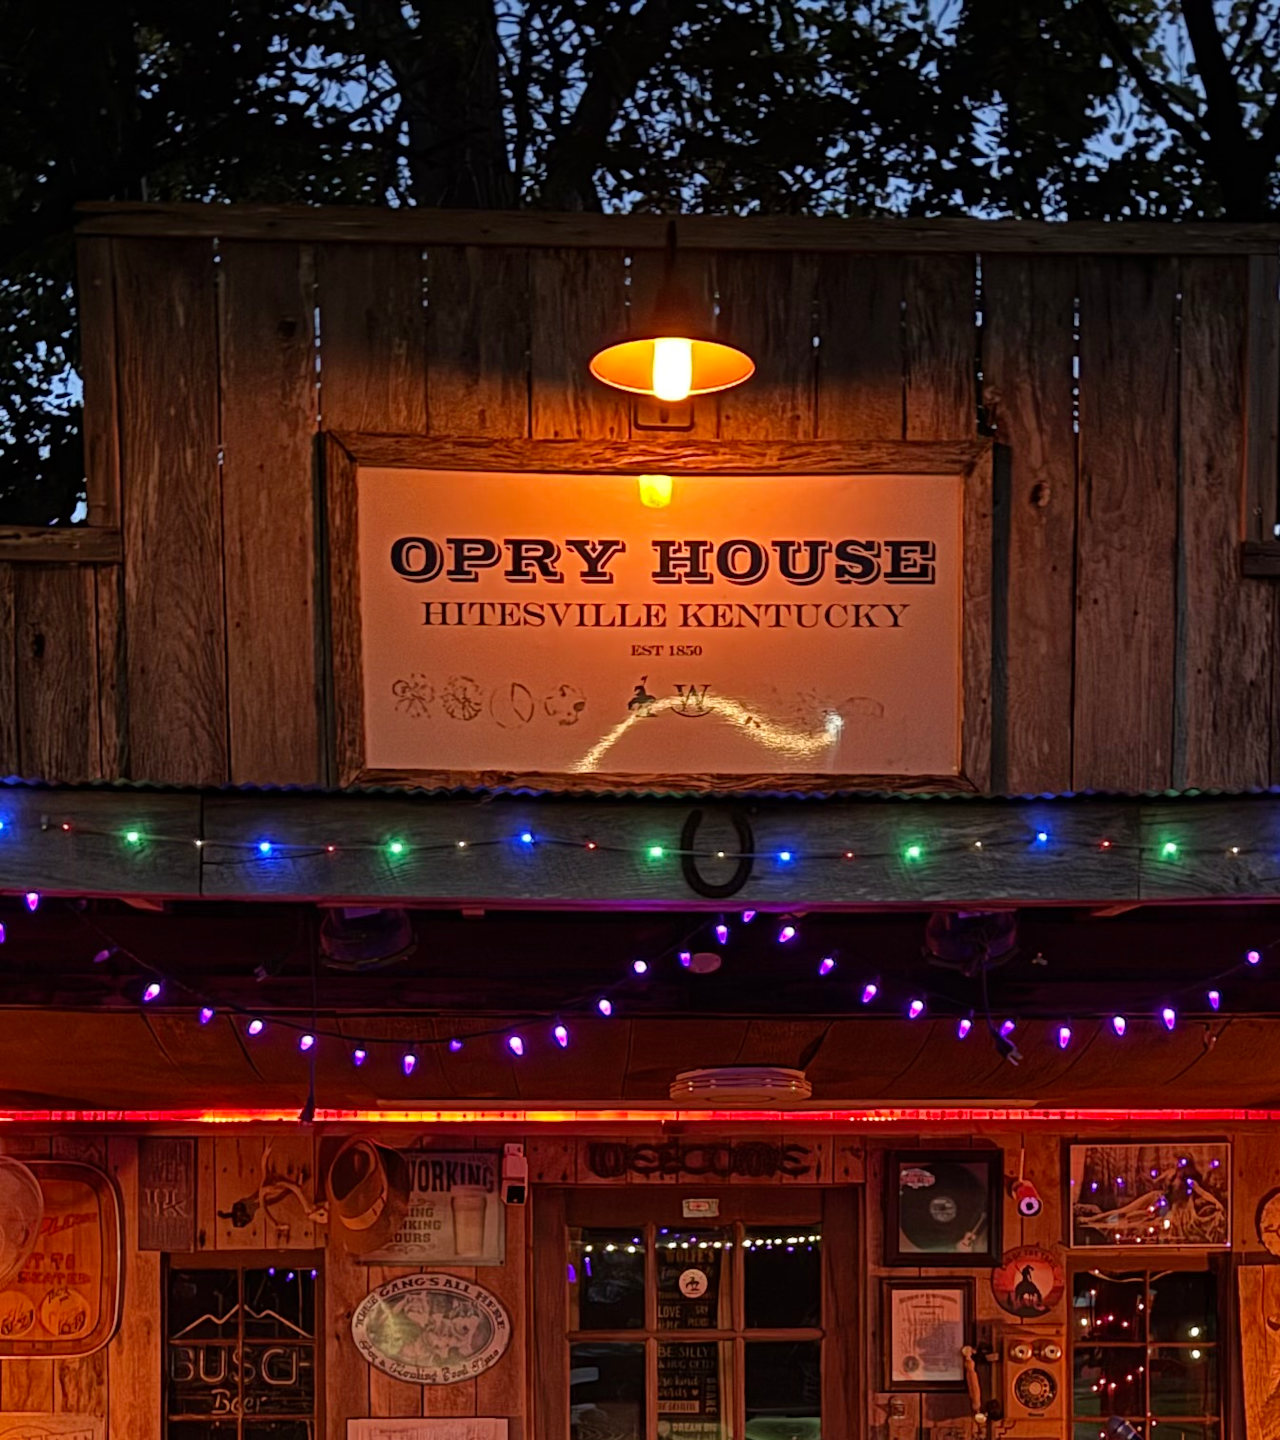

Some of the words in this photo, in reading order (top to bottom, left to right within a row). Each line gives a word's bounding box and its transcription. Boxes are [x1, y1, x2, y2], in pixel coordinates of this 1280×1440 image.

[390, 537, 626, 584] OPRY
[651, 538, 936, 586] HOUSE
[421, 601, 667, 628] HITESVILLE
[678, 603, 910, 629] KENTUCKY
[630, 644, 664, 657] EST
[668, 644, 703, 657] 1850
[443, 1279, 472, 1294] ALL
[475, 1290, 505, 1331] HERE
[657, 1305, 681, 1318] LOVE
[210, 1388, 269, 1415] Beer
